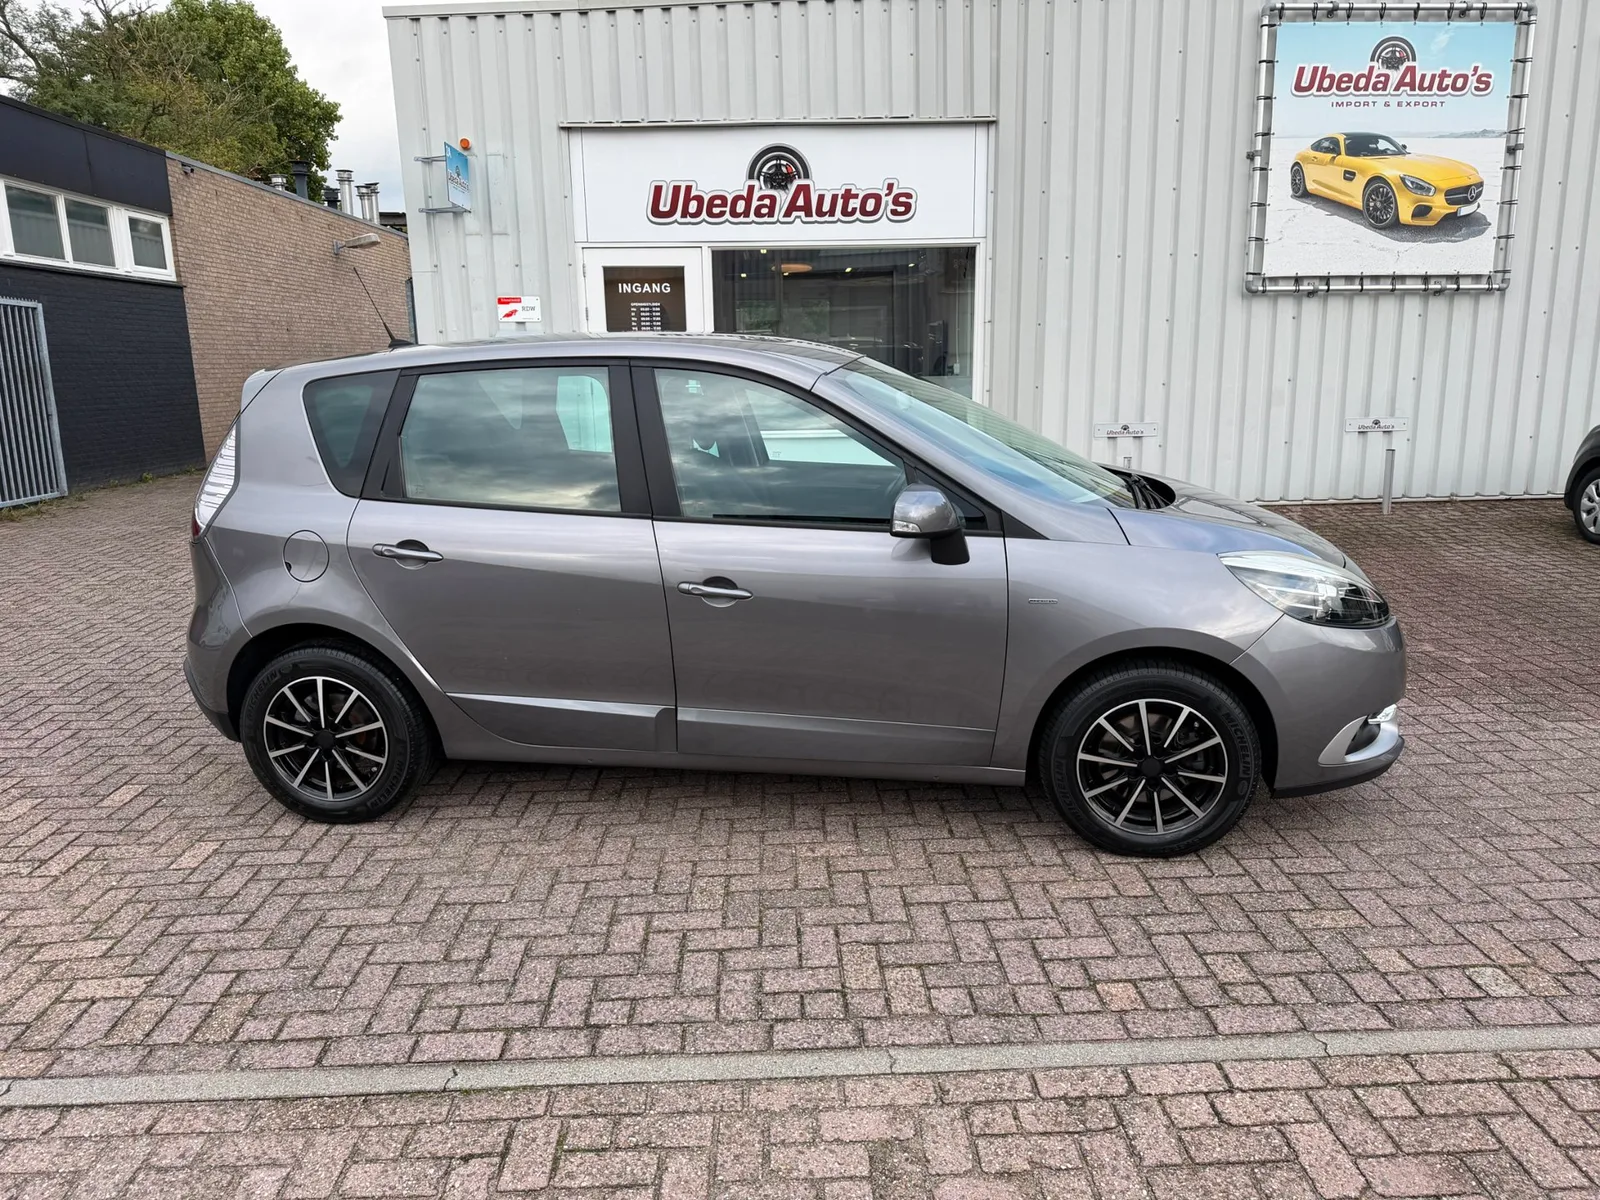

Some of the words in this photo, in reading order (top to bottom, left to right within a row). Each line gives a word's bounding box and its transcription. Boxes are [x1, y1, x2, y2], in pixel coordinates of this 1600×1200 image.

[1293, 65, 1390, 93] Ubeda
[1392, 64, 1493, 93] Auto's
[1331, 100, 1377, 108] IMPORT
[1383, 100, 1391, 108] &
[1396, 100, 1446, 108] EXPORT
[650, 184, 779, 219] Ubeda
[781, 182, 914, 219] Auto's
[618, 283, 671, 293] INGANG
[1222, 712, 1250, 776] MICHELIN
